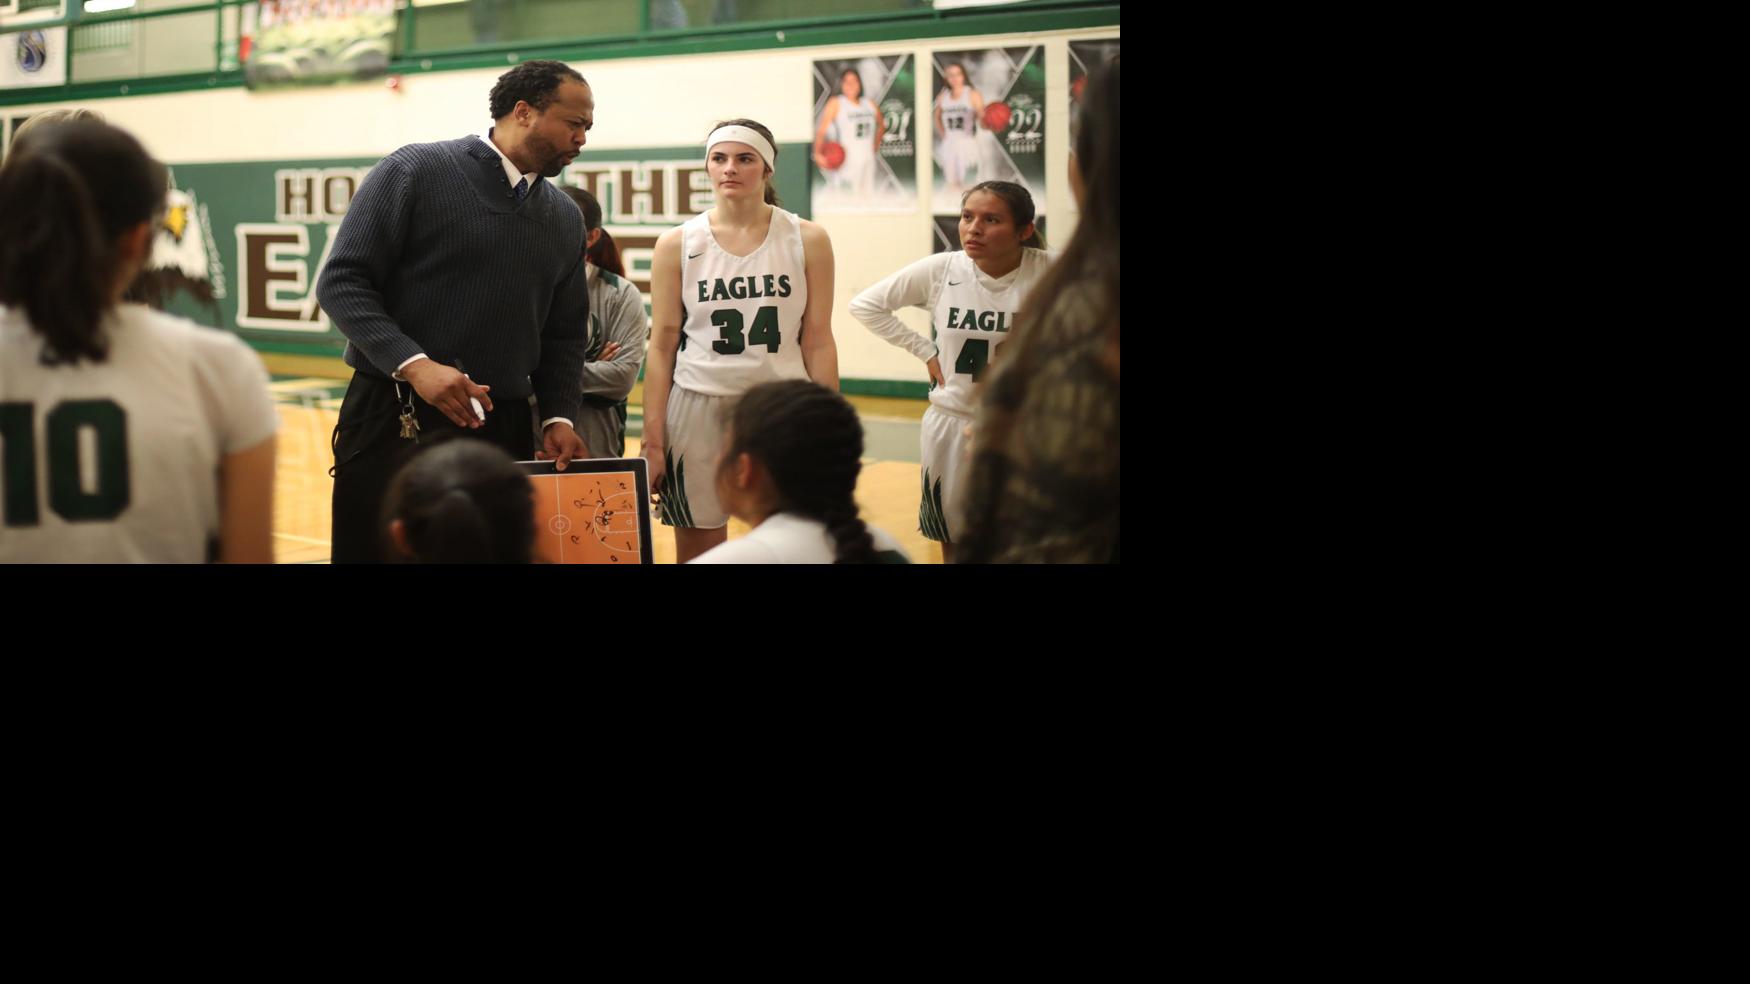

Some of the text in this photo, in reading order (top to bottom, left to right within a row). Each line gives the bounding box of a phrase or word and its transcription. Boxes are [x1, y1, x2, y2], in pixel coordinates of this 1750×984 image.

[1007, 108, 1042, 140] 22
[564, 161, 715, 224] THE
[697, 274, 792, 302] EAGLES
[710, 305, 782, 355] 34
[946, 307, 1014, 333] EAGL
[954, 338, 994, 384] 4
[0, 398, 132, 529] 10
